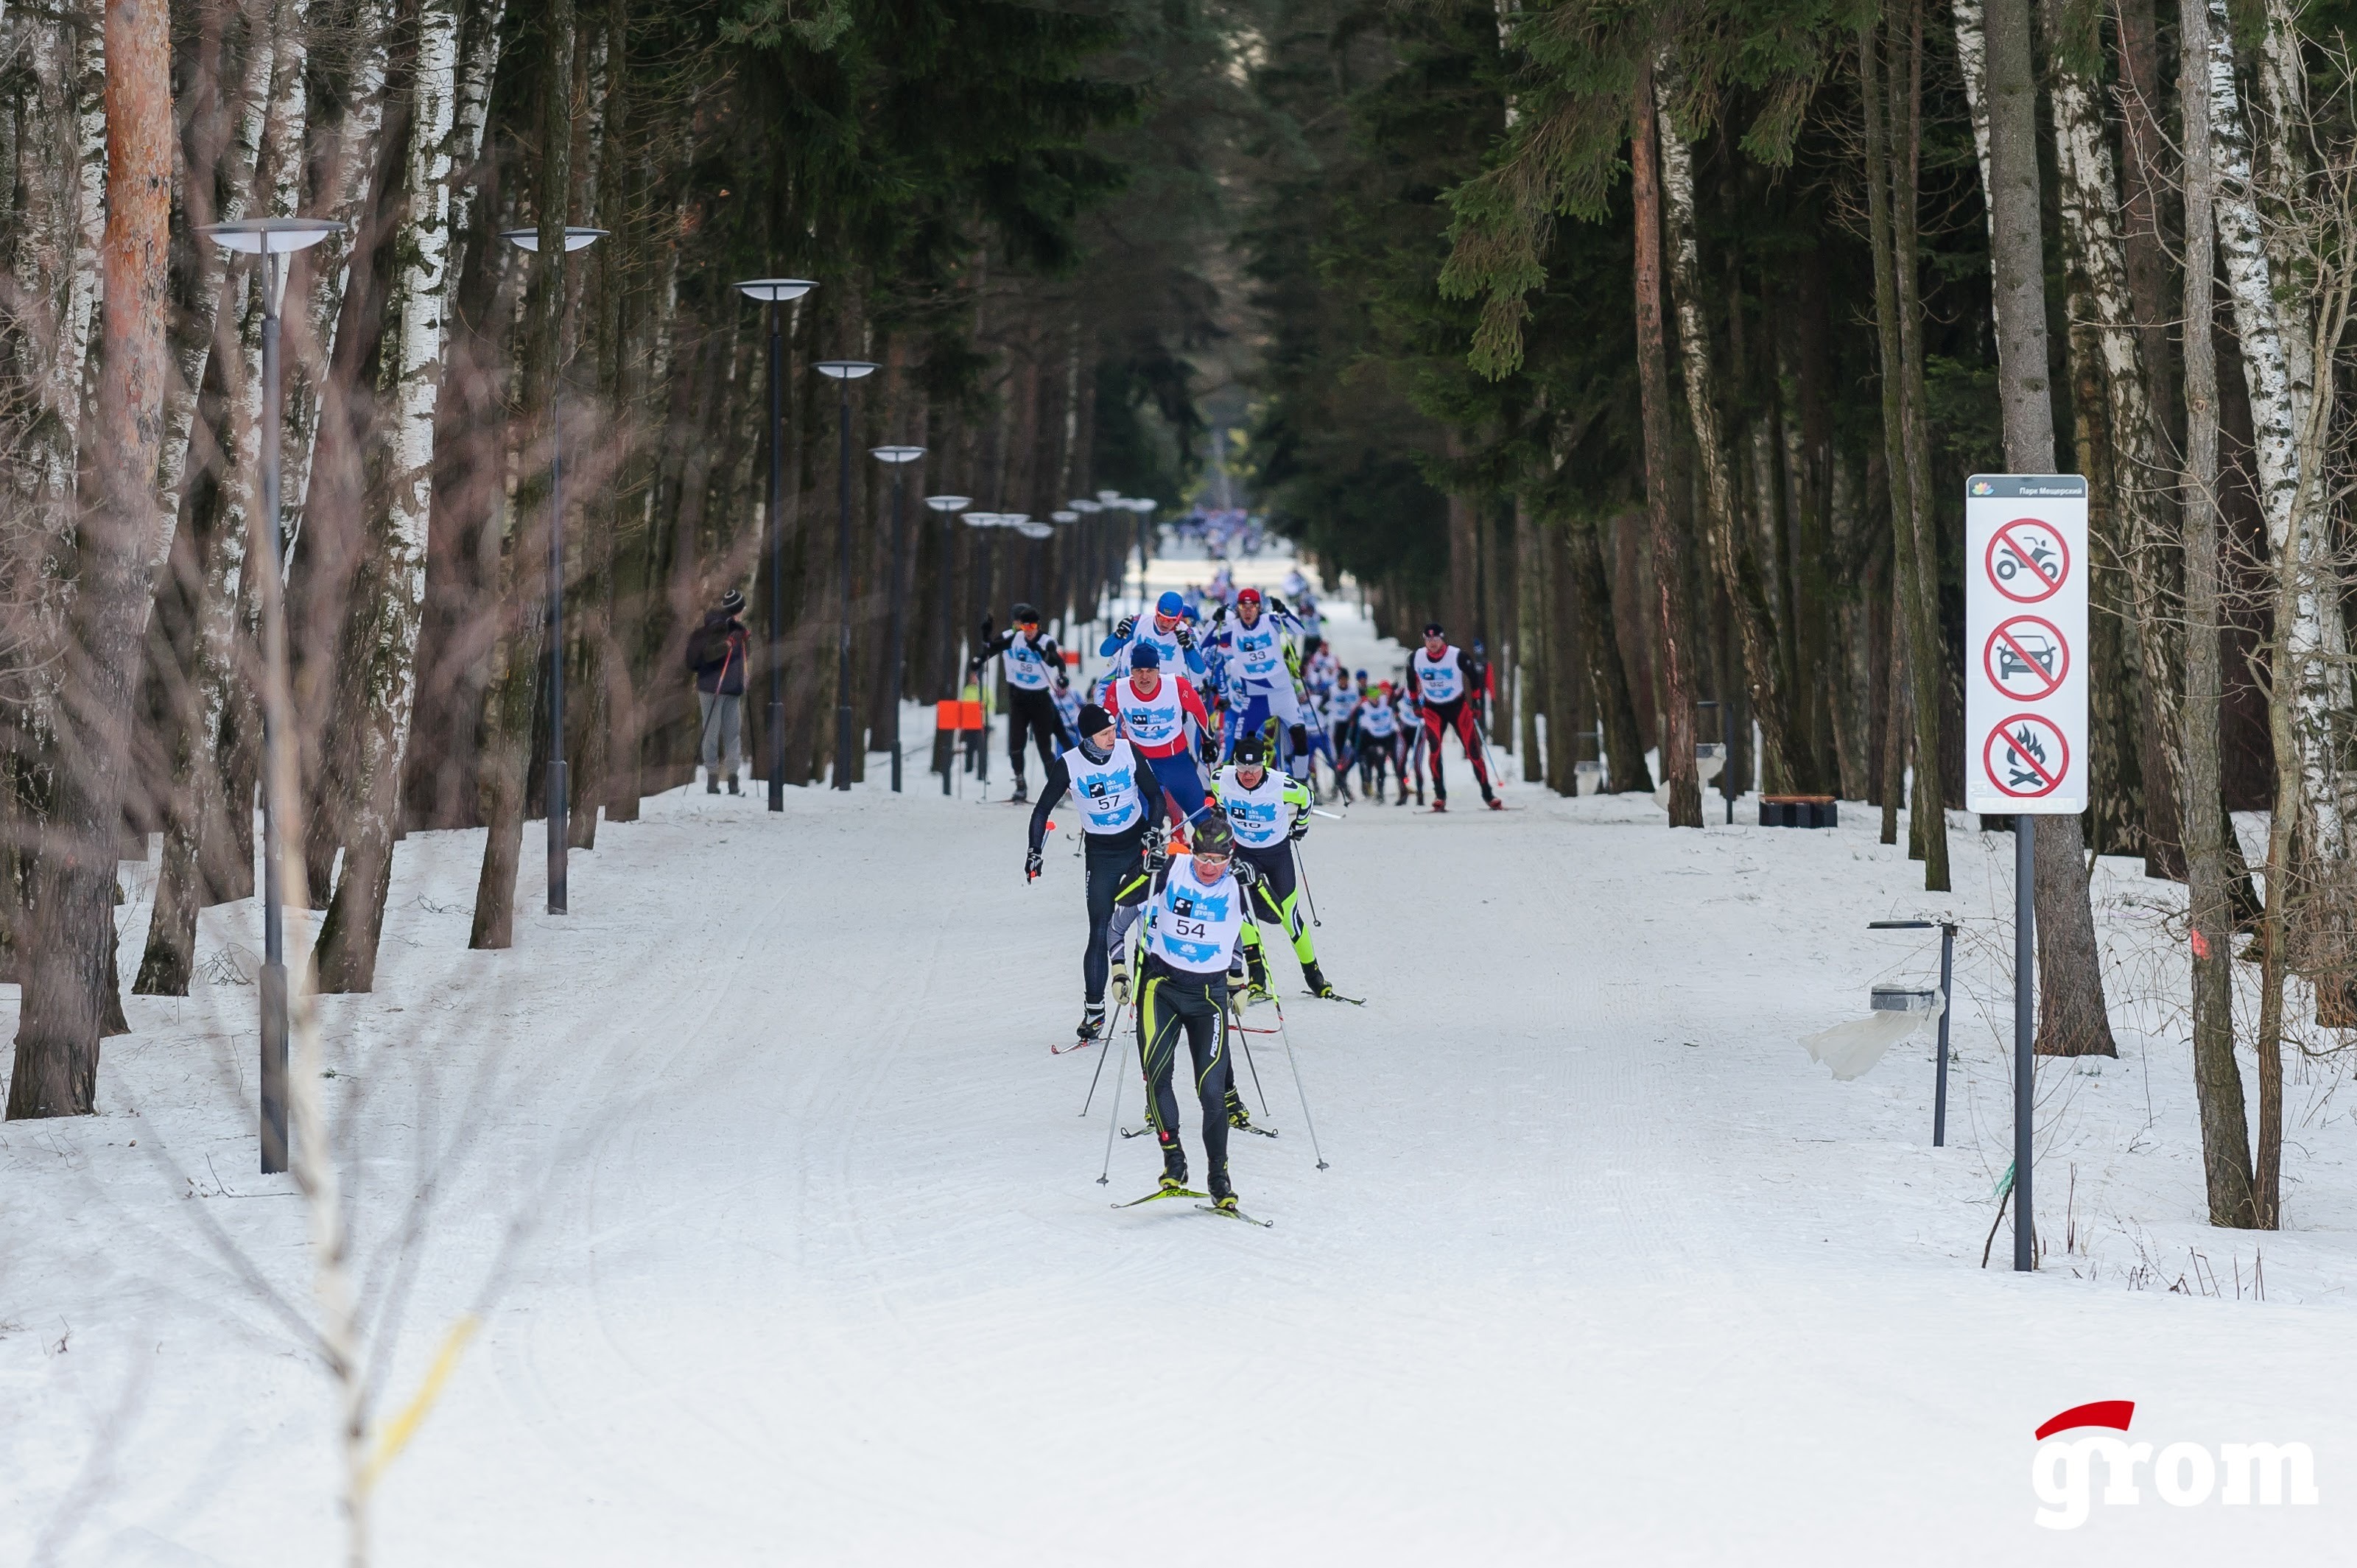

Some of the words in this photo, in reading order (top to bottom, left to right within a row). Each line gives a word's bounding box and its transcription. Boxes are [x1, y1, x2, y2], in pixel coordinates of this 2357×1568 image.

[2019, 487, 2038, 496] Парк
[2039, 487, 2083, 496] Мещерский
[1248, 651, 1266, 661] 33
[1097, 795, 1120, 810] 57
[1176, 918, 1205, 938] 54
[1209, 1018, 1220, 1058] FISCHER
